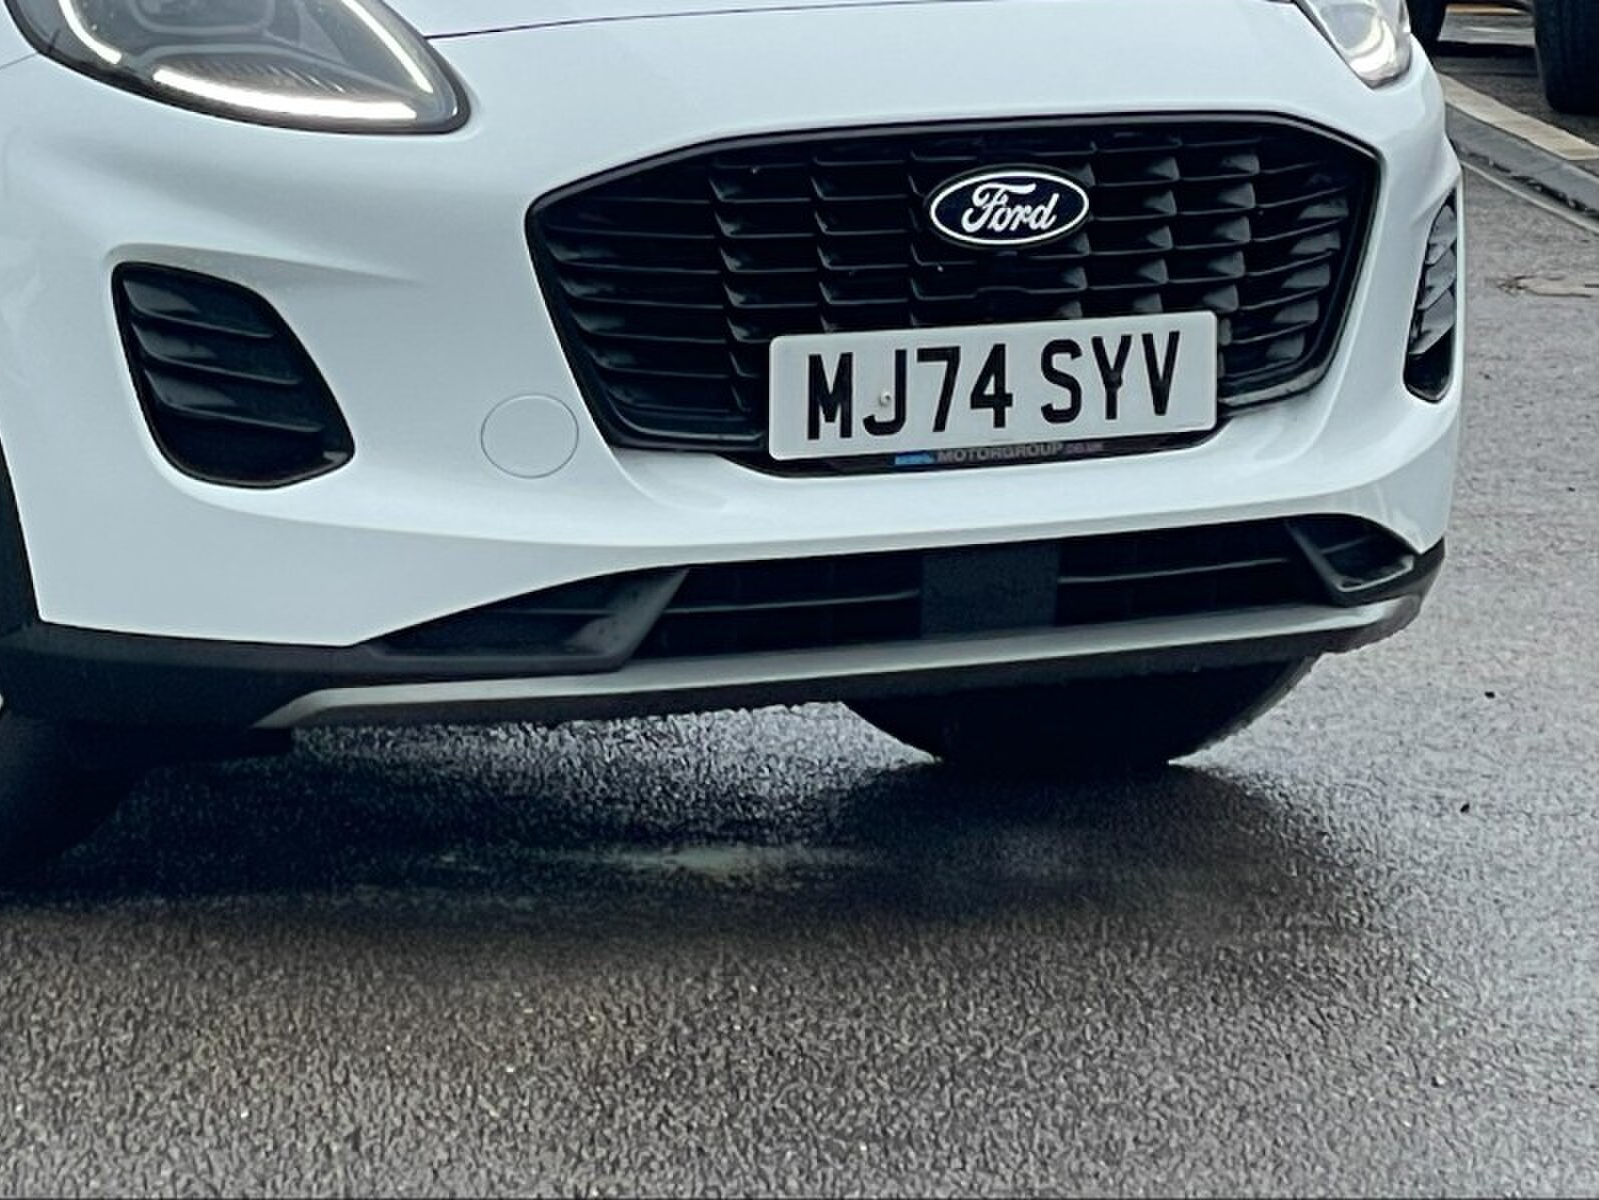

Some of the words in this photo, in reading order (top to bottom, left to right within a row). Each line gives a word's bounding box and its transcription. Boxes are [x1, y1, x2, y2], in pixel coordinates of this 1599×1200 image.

[961, 182, 1058, 232] Ford
[806, 343, 1014, 441] MJ74
[1040, 330, 1181, 425] SYV
